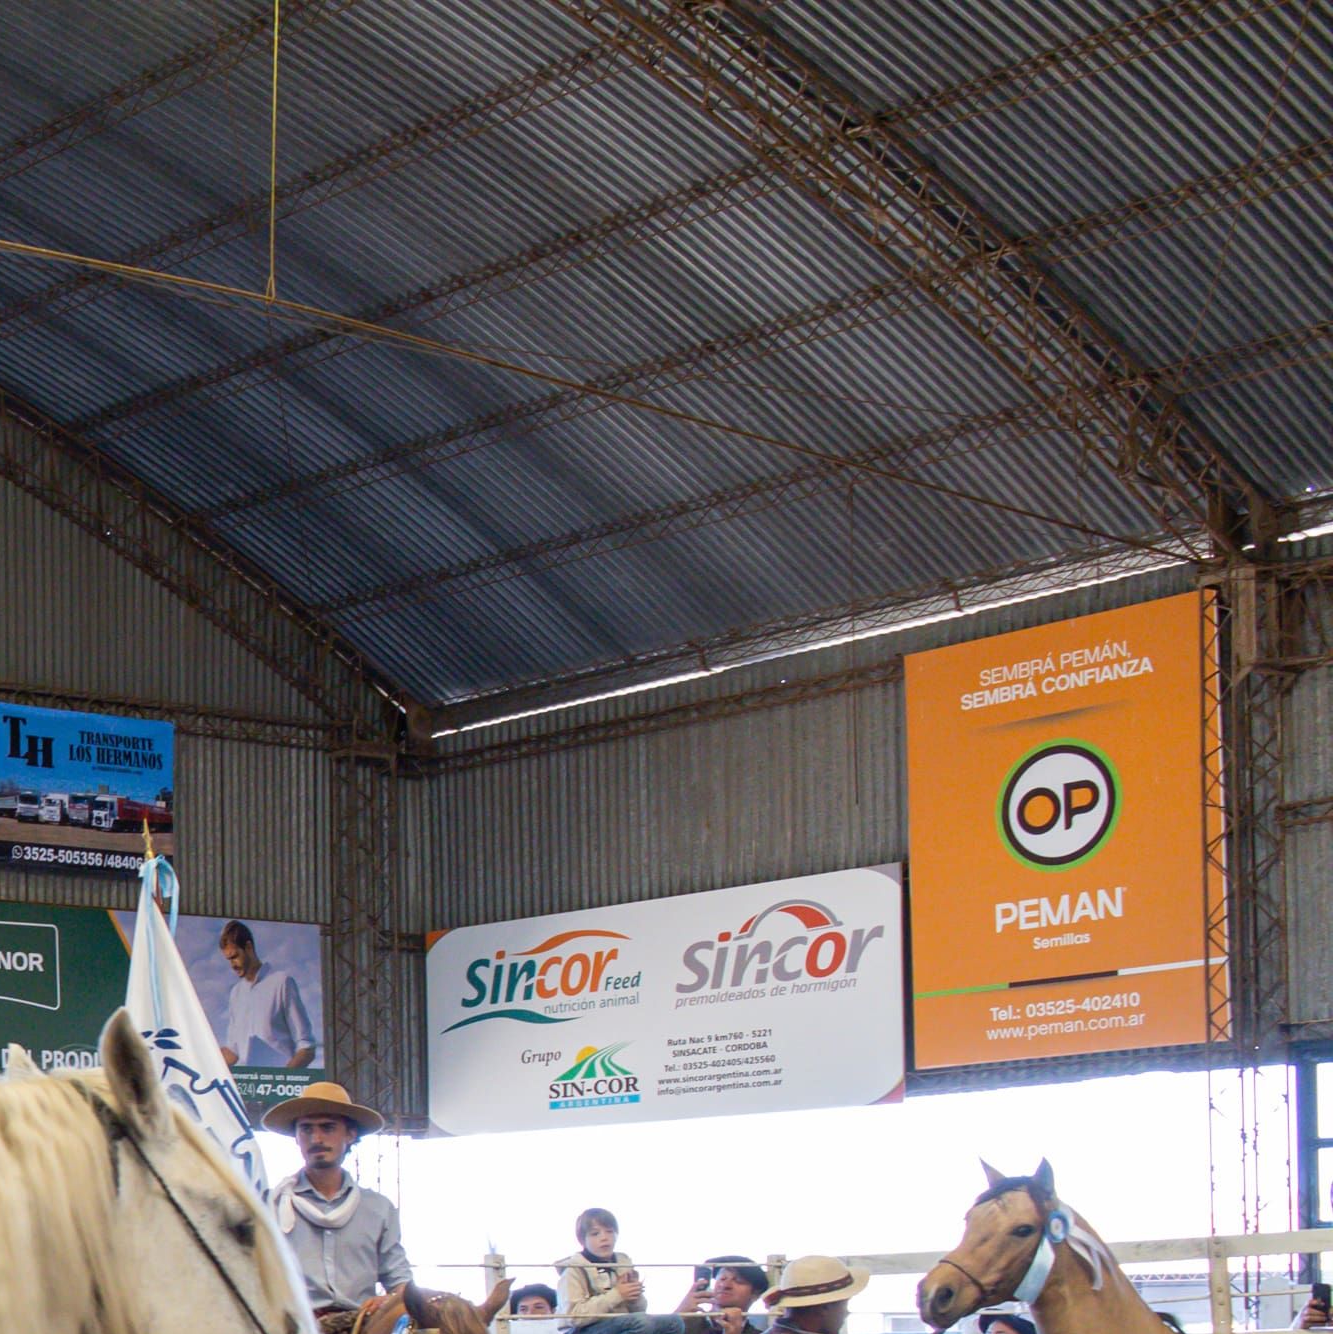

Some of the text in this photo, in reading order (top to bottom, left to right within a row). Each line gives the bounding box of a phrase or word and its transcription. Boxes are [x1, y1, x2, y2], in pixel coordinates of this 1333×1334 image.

[979, 640, 1132, 687] SEMBRÁ PEMÁN,
[960, 657, 1154, 710] SEMBRÁ CONFIANZA
[78, 731, 154, 750] TRANSPORTE
[69, 744, 163, 770] LOS HERMANOS
[1017, 780, 1100, 835] OP
[23, 846, 102, 866] 3525-505356
[995, 886, 1124, 933] PEMAN
[1033, 933, 1091, 949] Semillas
[605, 971, 641, 992] Feed
[675, 976, 857, 1009] premoldeados de hormigón
[544, 992, 639, 1015] nutrición animal
[989, 992, 1141, 1022] Tel.: 03525-402410
[667, 1038, 687, 1047] Ruta
[689, 1035, 705, 1044] Nac
[751, 1028, 773, 1038] 5221
[986, 1013, 1146, 1040] www.peman.com.ar
[521, 1049, 562, 1066] Grupo
[672, 1041, 769, 1058] SINSACATE CORDOBA
[549, 1076, 640, 1099] SIN-COR
[658, 1068, 782, 1085] www.sincorargentina.com.ar
[256, 1084, 309, 1097] 47-009
